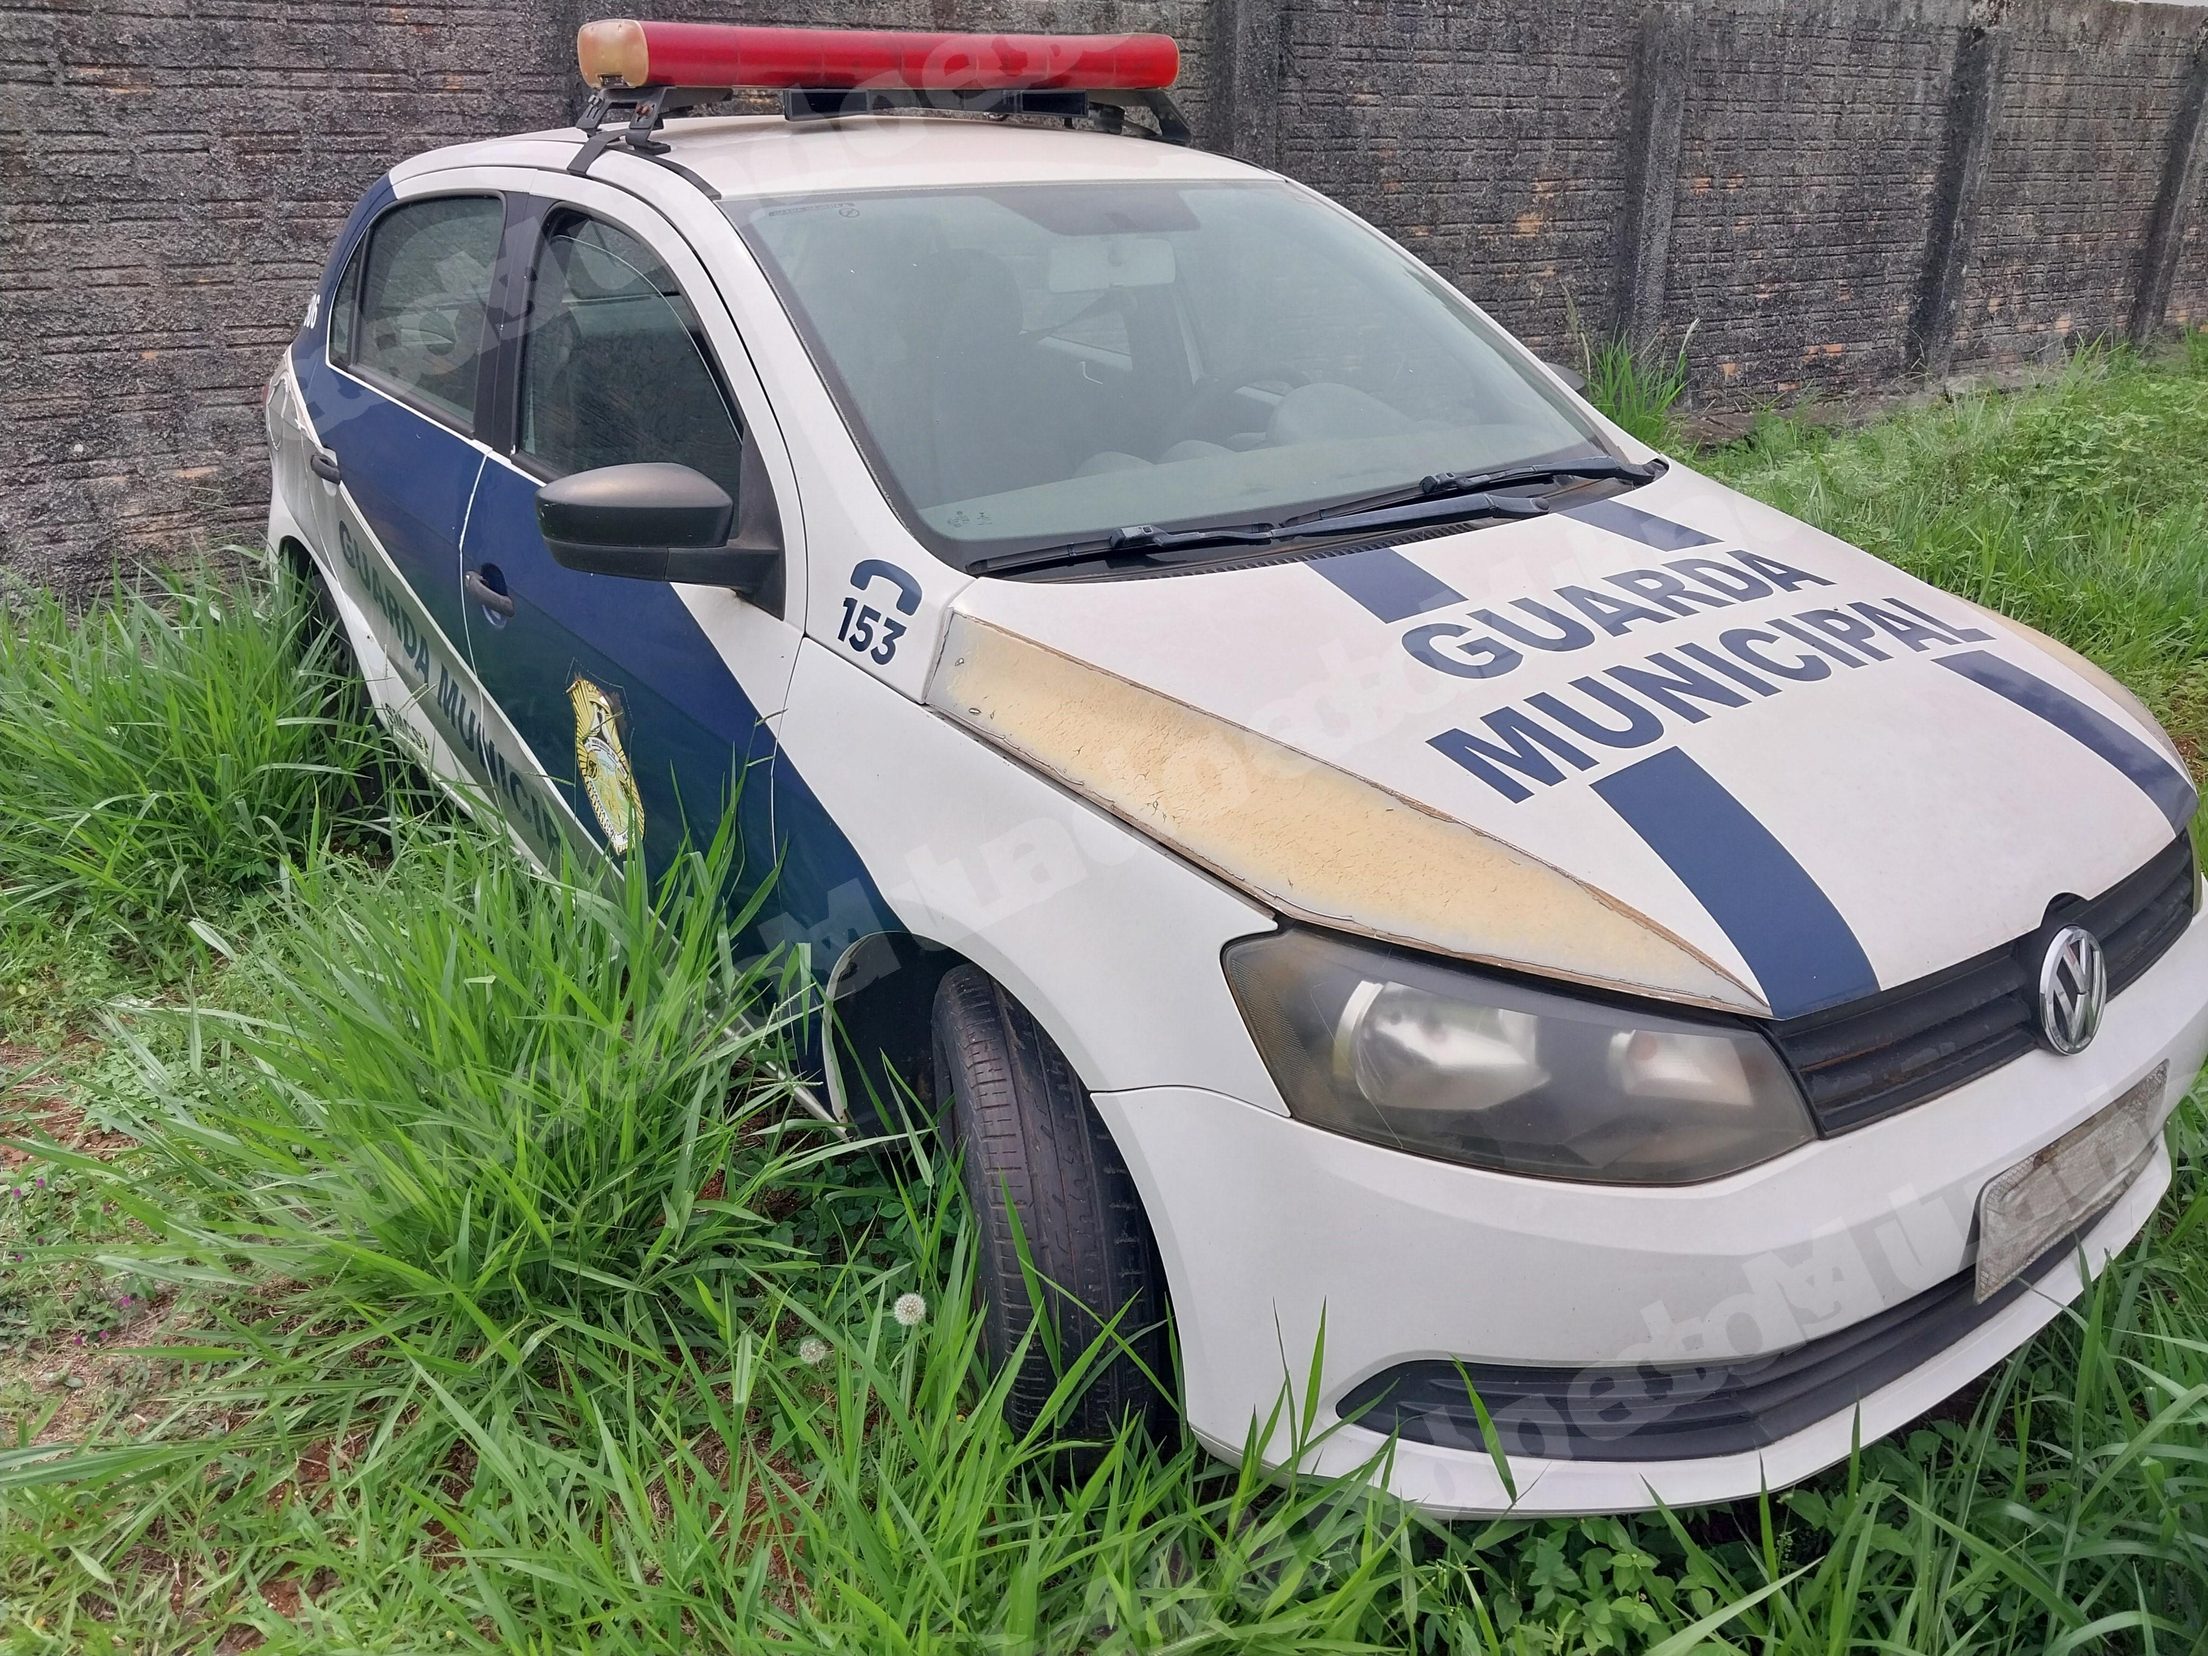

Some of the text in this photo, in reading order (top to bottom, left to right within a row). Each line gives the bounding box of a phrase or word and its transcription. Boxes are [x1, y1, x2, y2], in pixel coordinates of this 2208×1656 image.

[339, 520, 431, 684] GUARDA
[838, 597, 907, 665] 153
[1401, 549, 1837, 679] GUARDA
[1425, 597, 1996, 803] MUNICIPAL
